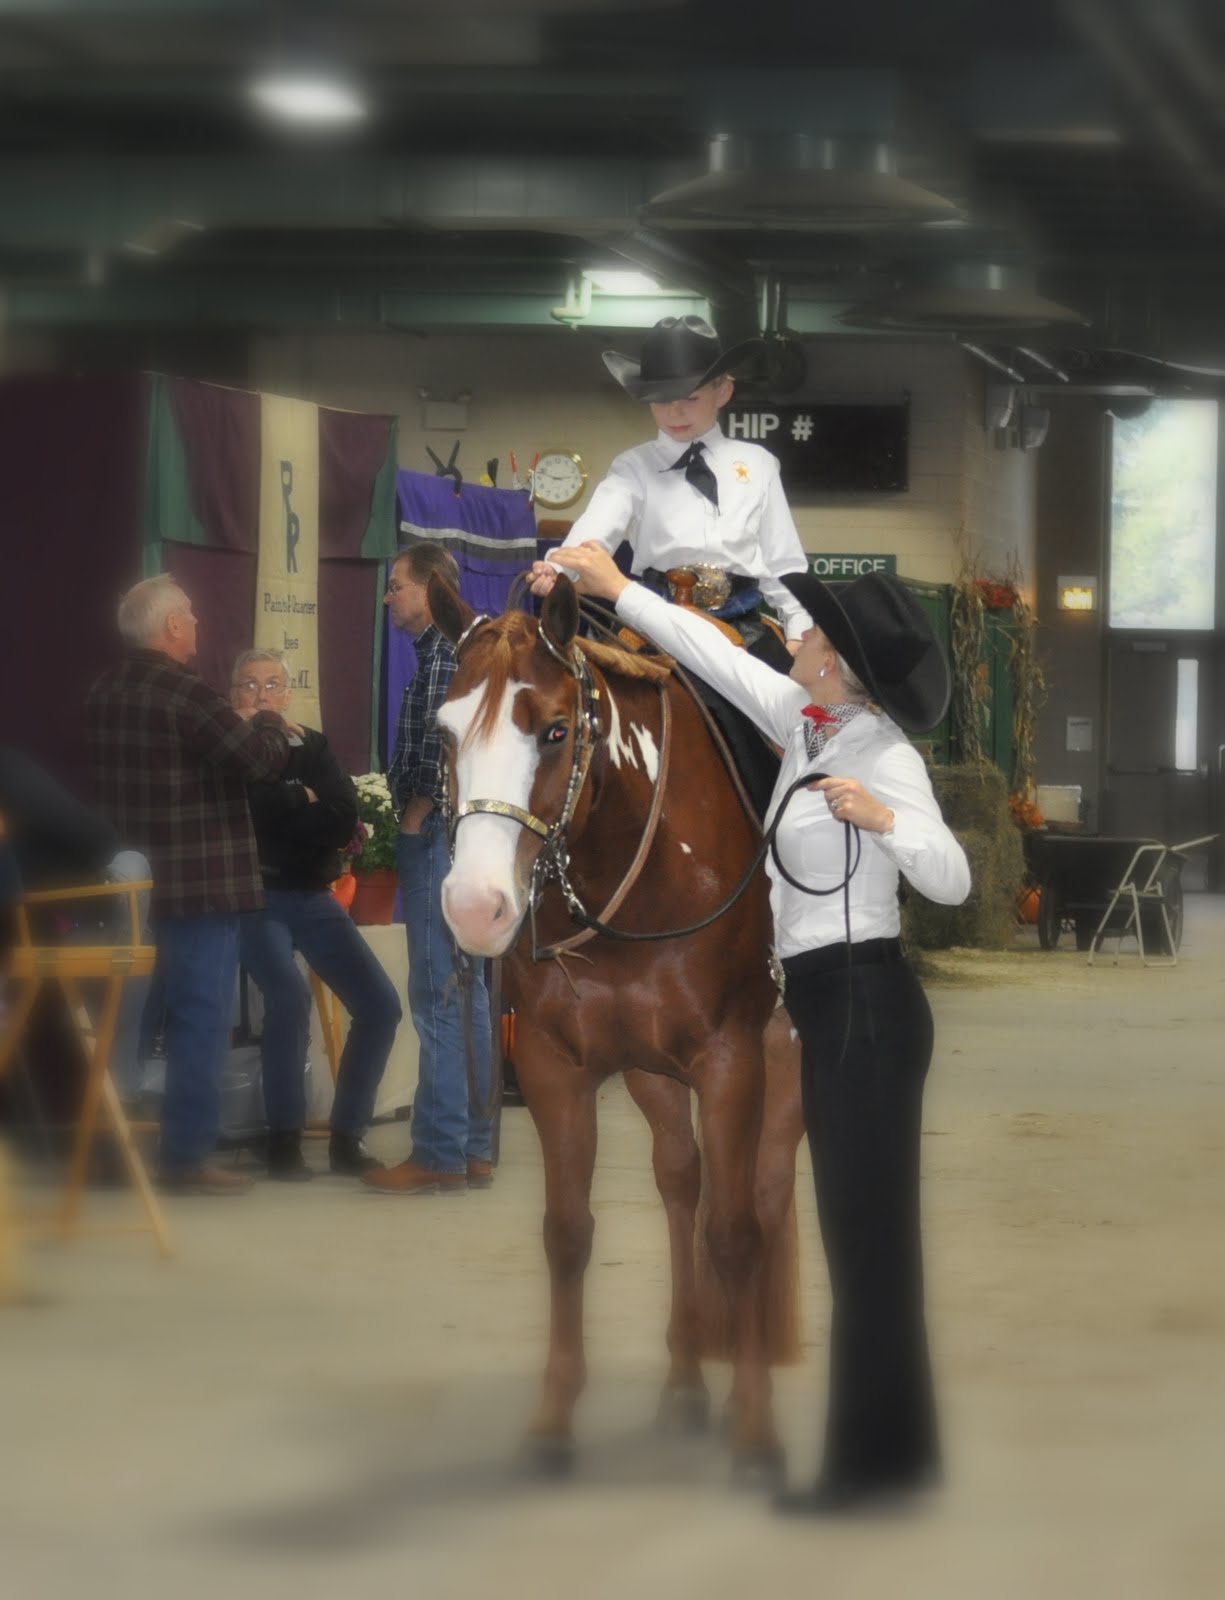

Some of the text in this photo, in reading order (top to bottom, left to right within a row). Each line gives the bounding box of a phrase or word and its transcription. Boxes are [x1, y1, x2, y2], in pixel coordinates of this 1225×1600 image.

[729, 413, 814, 441] HIP #
[813, 558, 887, 575] OFFICE
